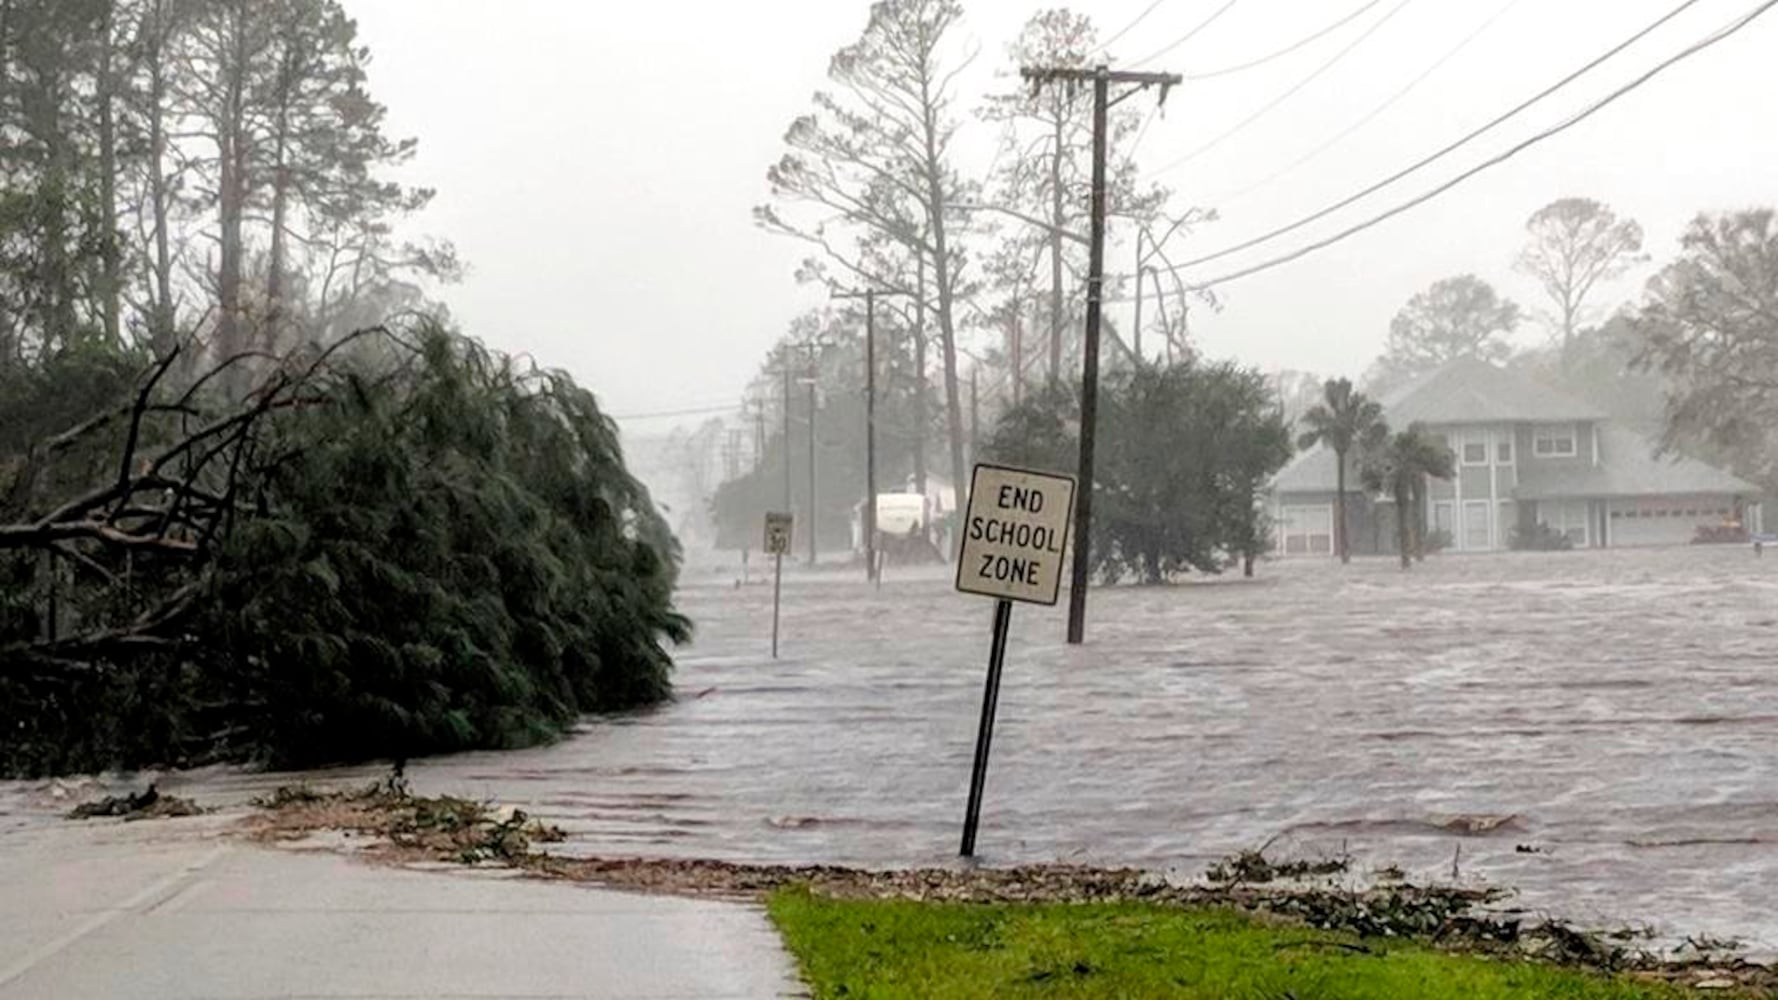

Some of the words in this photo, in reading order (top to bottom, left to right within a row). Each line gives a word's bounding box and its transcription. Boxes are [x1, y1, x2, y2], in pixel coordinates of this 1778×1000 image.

[998, 485, 1043, 513] END
[970, 517, 1059, 553] SCHOOL
[979, 554, 1040, 585] ZONE
